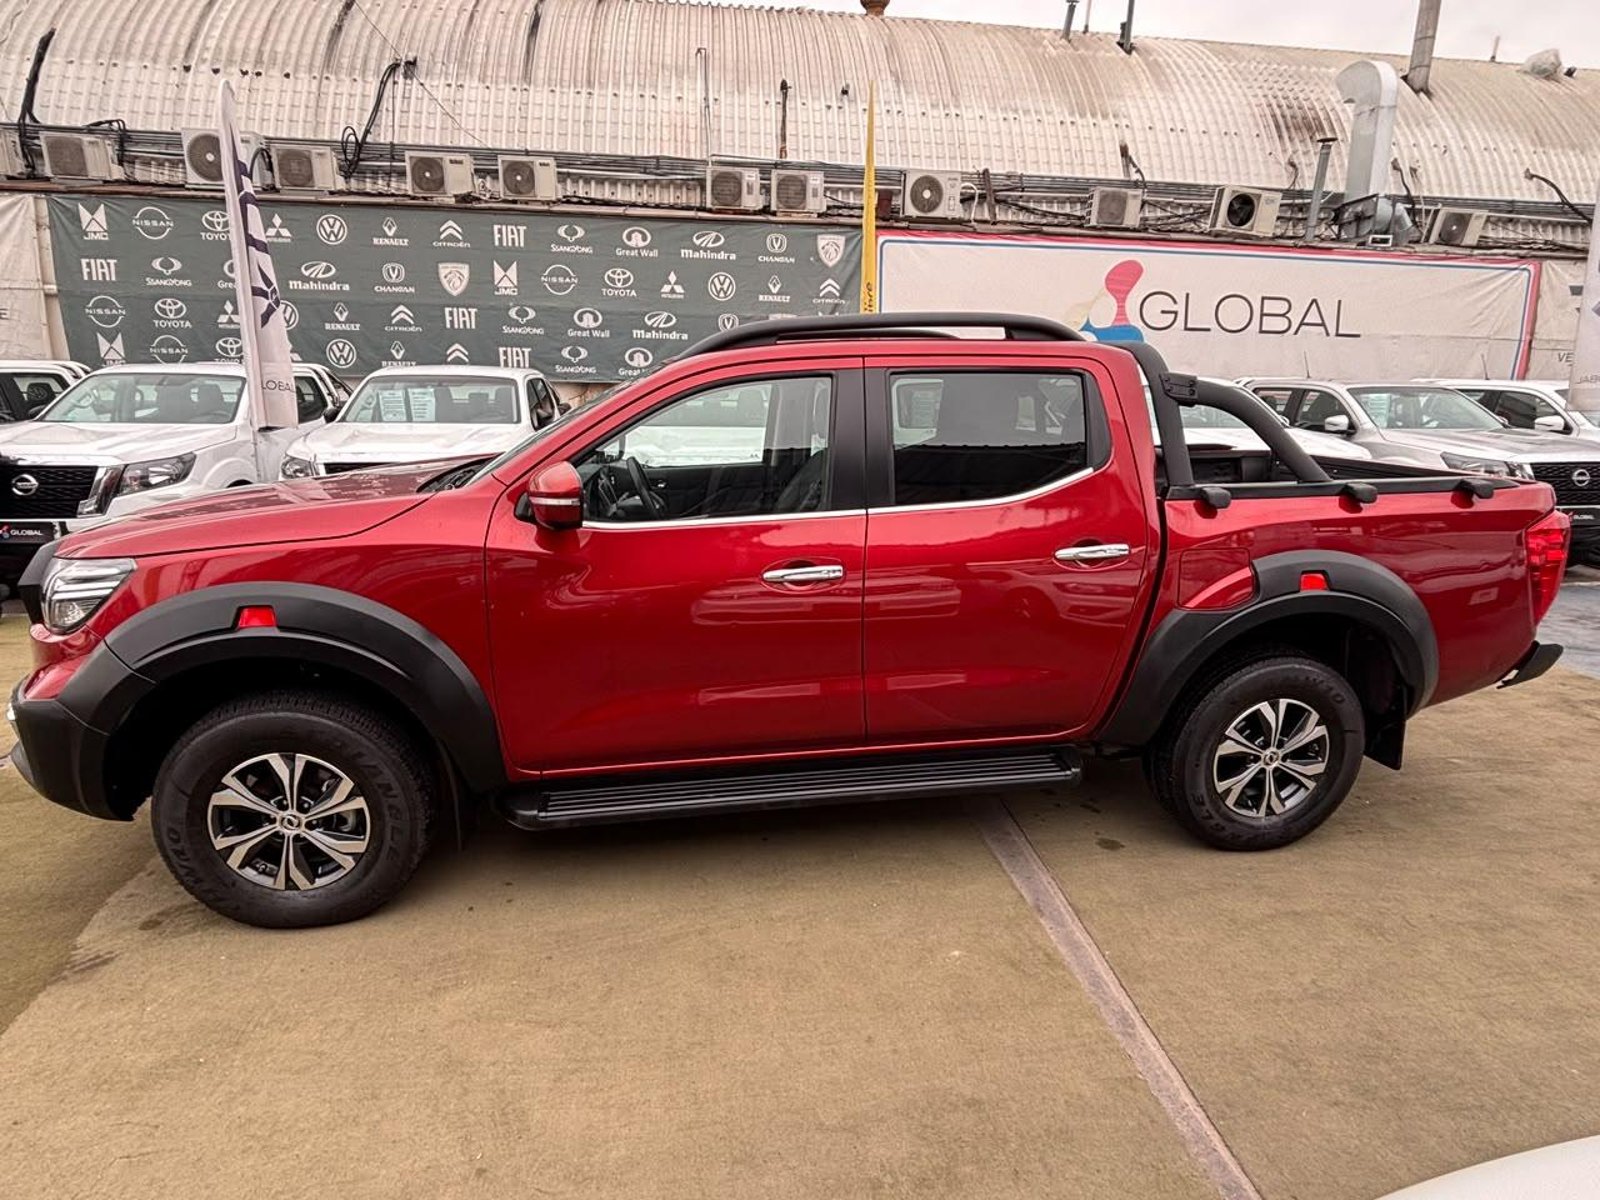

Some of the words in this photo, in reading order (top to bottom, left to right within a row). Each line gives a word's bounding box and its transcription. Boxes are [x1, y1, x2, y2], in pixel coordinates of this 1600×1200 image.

[132, 219, 174, 227] NISSAN
[83, 232, 109, 240] JMC
[494, 224, 527, 247] FIAT
[373, 237, 409, 246] RENAULT
[616, 247, 638, 257] Great
[640, 248, 658, 257] Wall
[681, 249, 736, 260] Mahindra
[81, 259, 117, 281] FIAT
[541, 275, 578, 284] NISSAN
[289, 280, 350, 291] Mahindra
[495, 287, 518, 295] JMC
[602, 288, 637, 297] TOYOTA
[85, 307, 126, 315] NISSAN
[1139, 290, 1361, 338] GLOBAL
[444, 307, 477, 330] FIAT
[153, 319, 192, 329] TOYOTA
[325, 322, 361, 331] RENAULT
[568, 328, 589, 338] Great
[591, 330, 610, 339] Wall
[632, 329, 689, 341] Mahindra
[499, 347, 531, 368] FIAT
